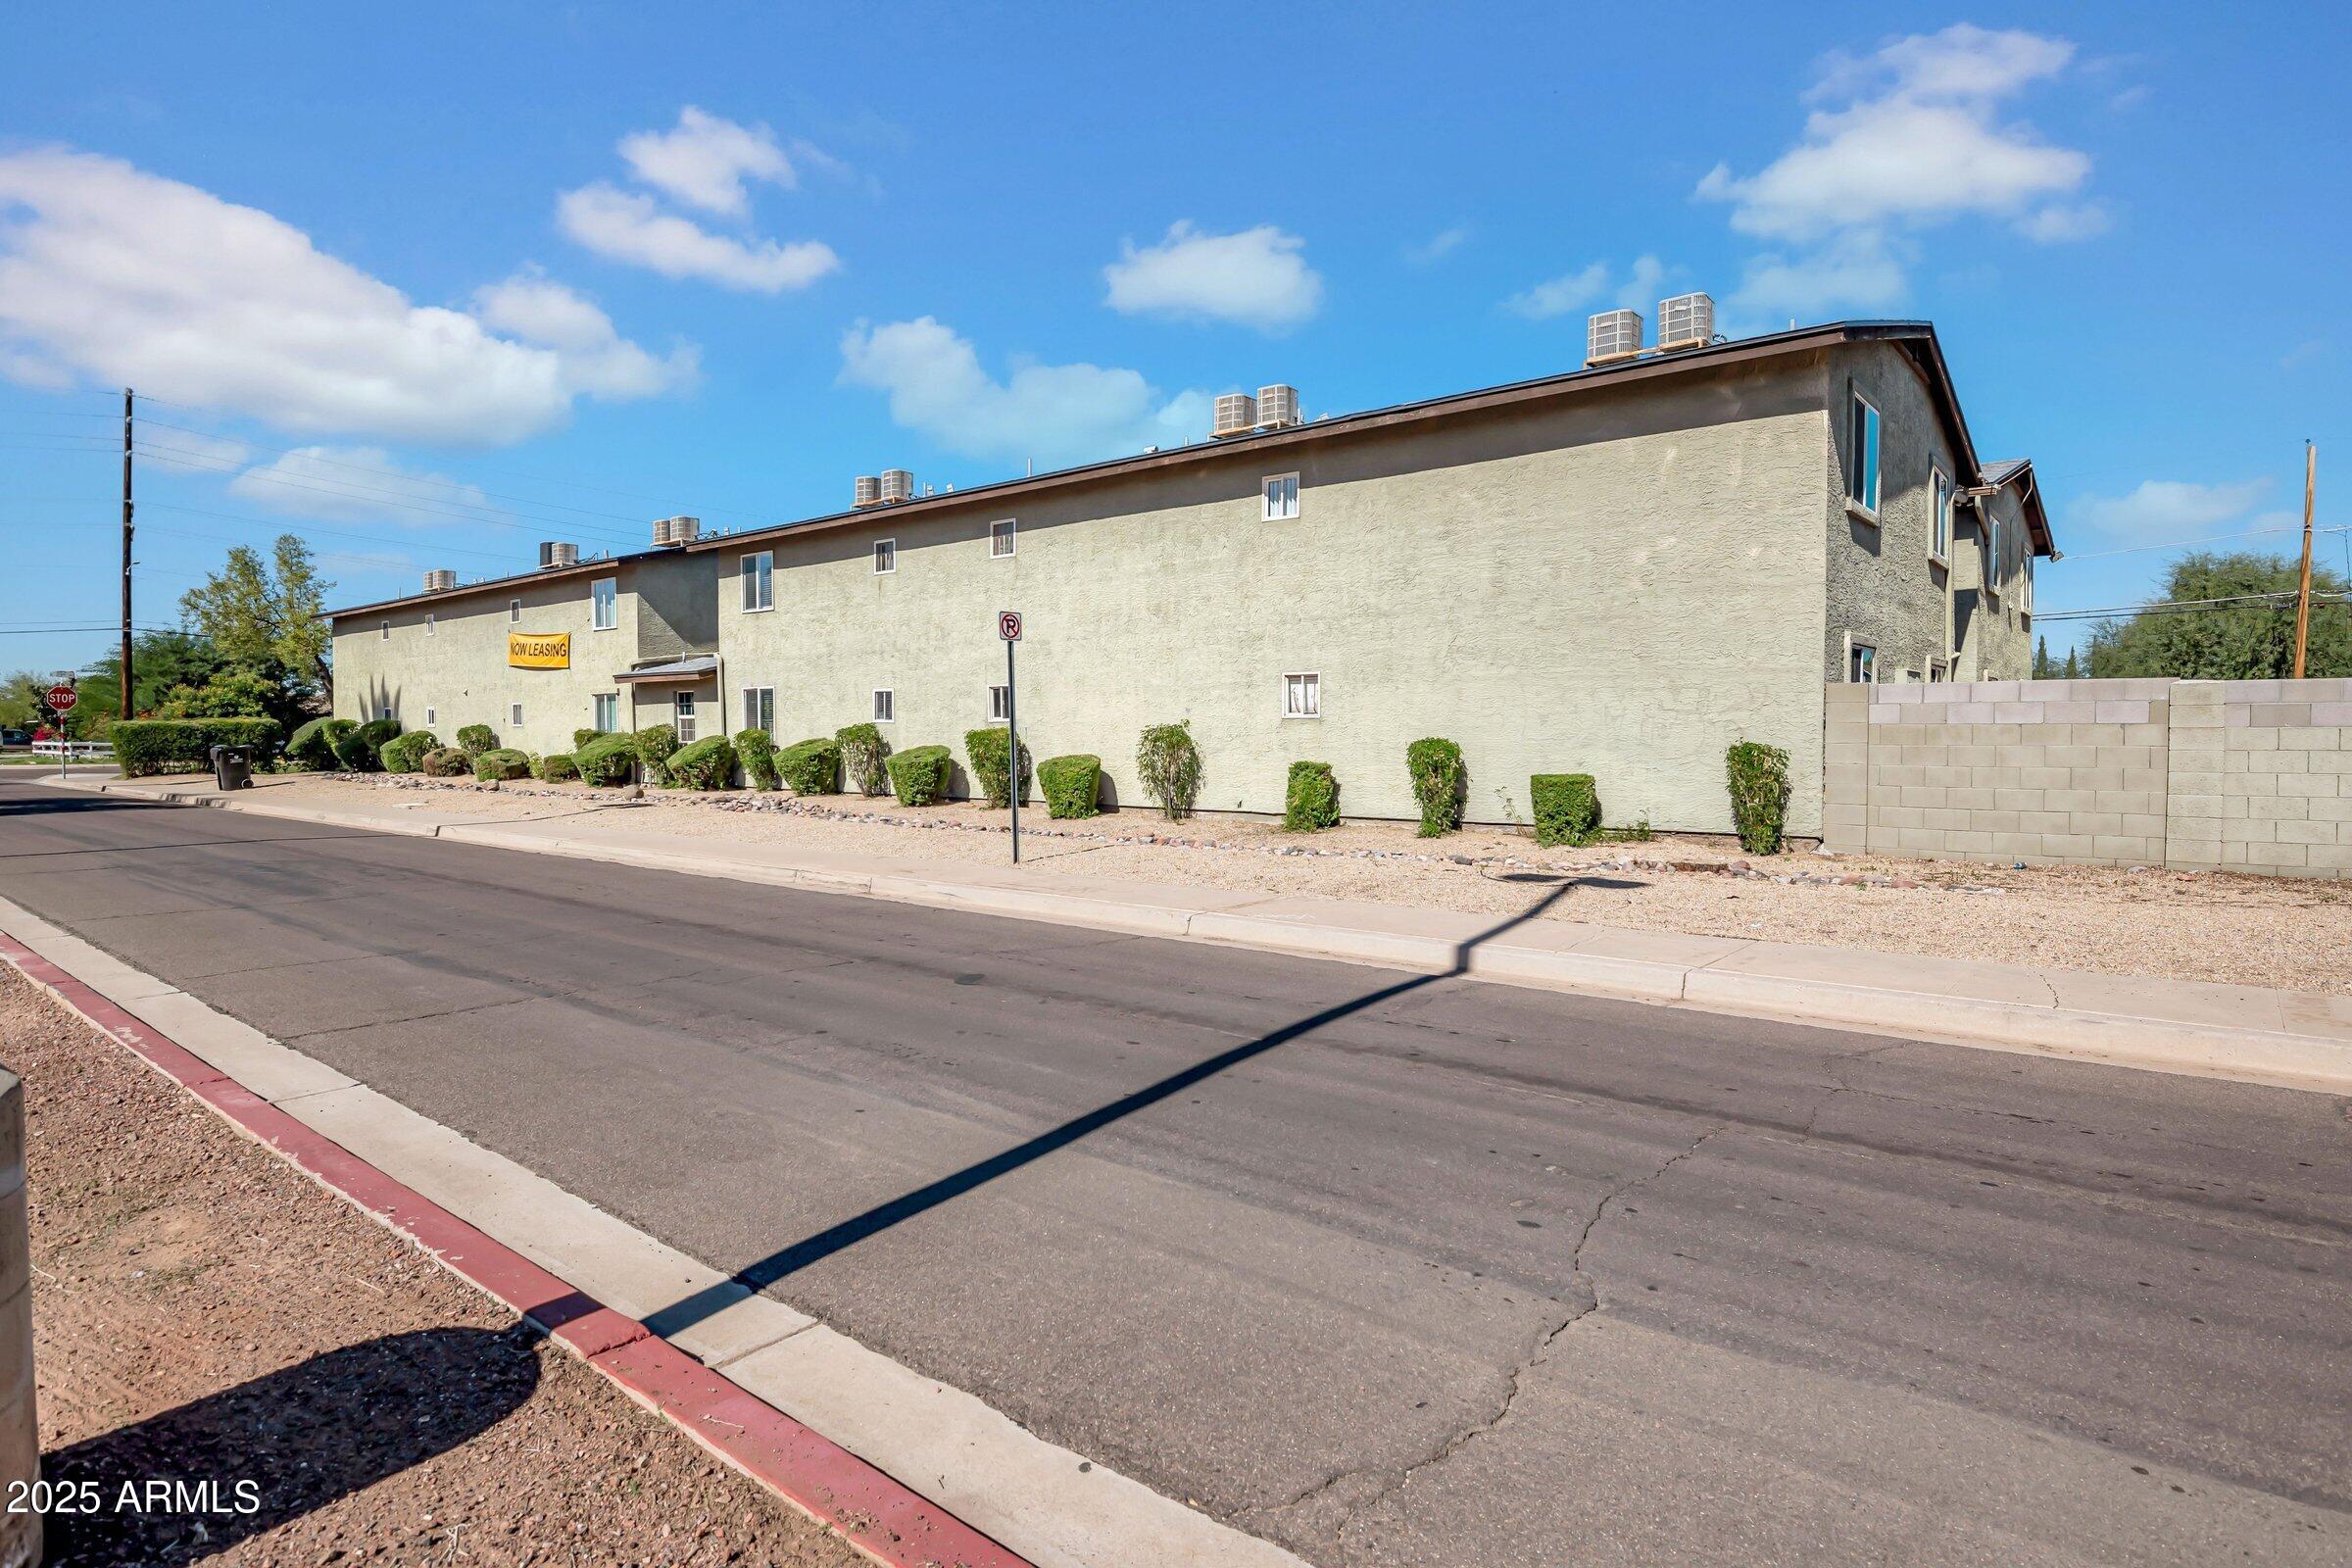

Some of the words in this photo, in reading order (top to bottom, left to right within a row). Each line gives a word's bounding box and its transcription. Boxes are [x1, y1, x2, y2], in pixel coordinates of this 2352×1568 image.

[1006, 618, 1016, 633] P
[528, 643, 567, 658] LEASING
[49, 693, 75, 704] STOP
